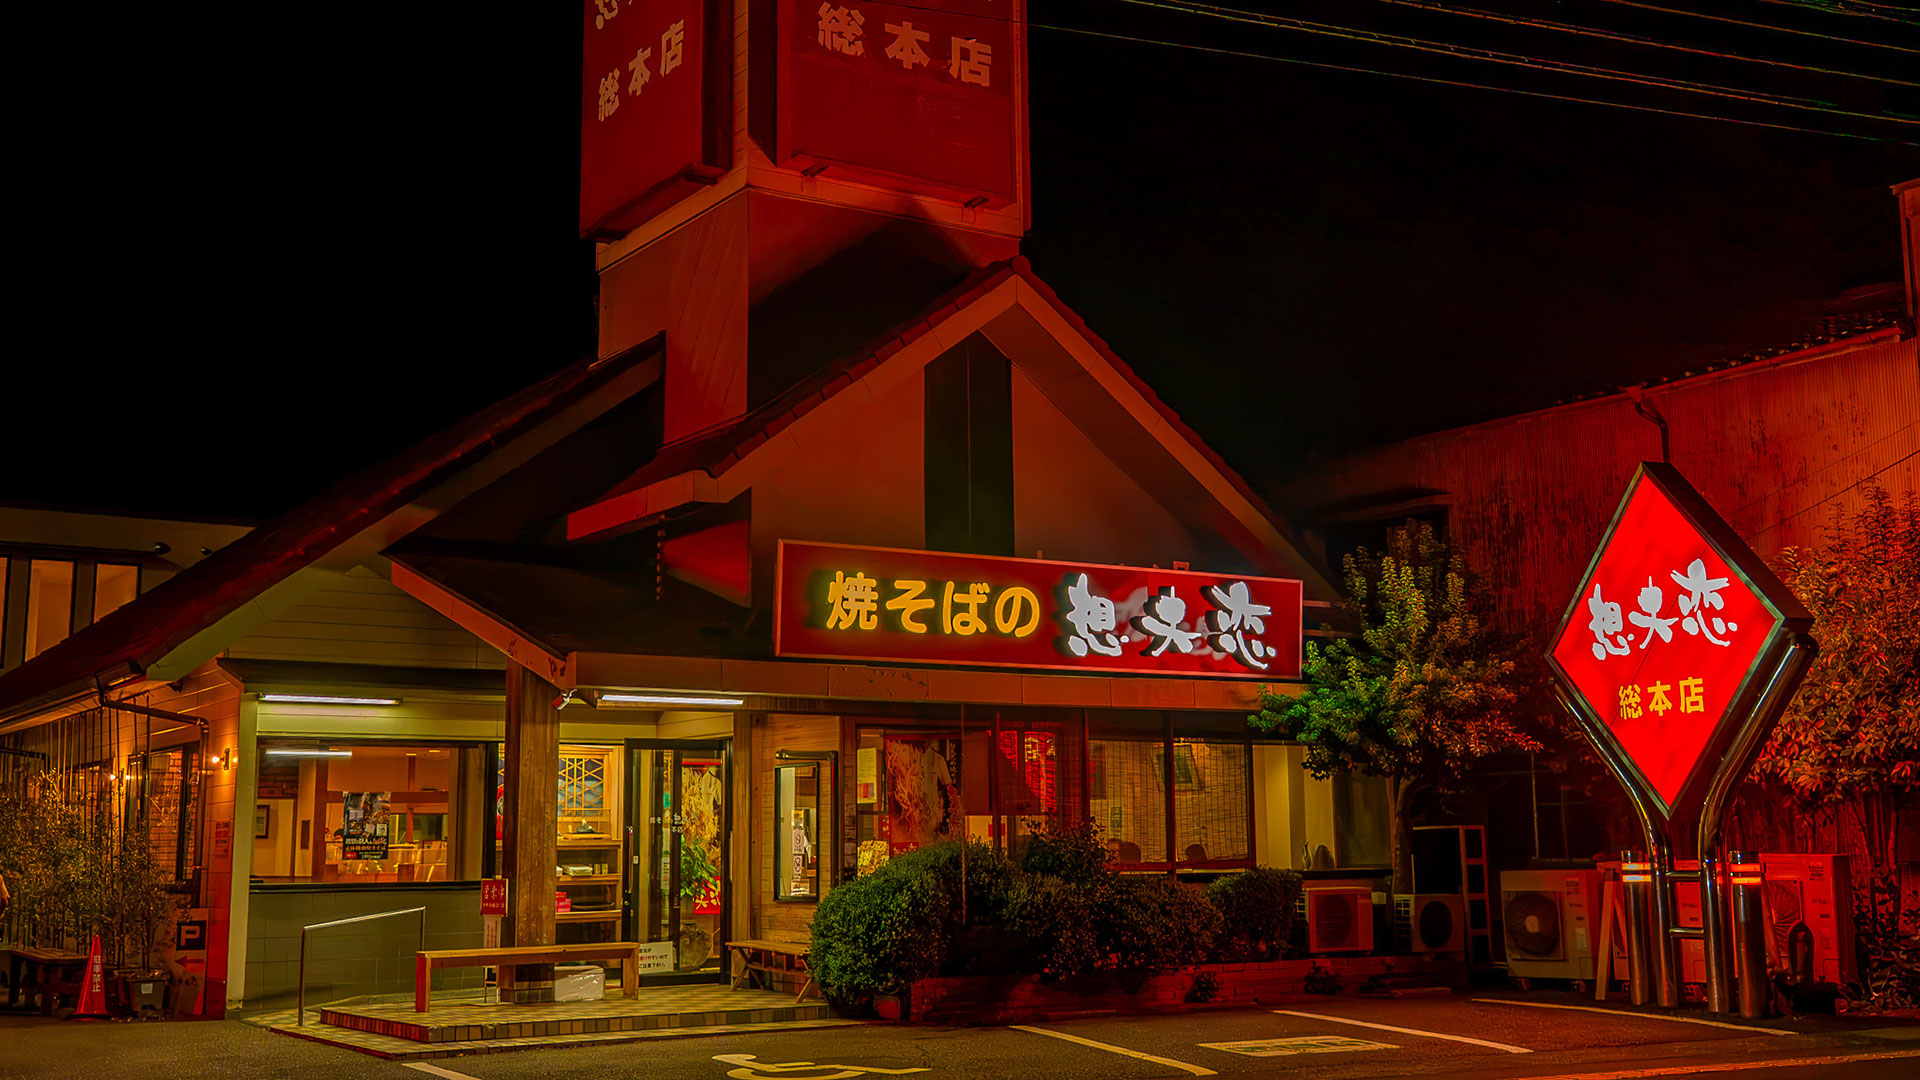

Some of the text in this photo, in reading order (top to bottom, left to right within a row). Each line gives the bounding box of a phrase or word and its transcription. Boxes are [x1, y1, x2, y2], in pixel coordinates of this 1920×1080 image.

[598, 20, 684, 122] 総本店
[817, 1, 992, 87] 総本店
[826, 570, 1040, 638] 焼そばの
[1618, 676, 1705, 720] 総本店
[181, 925, 200, 946] P
